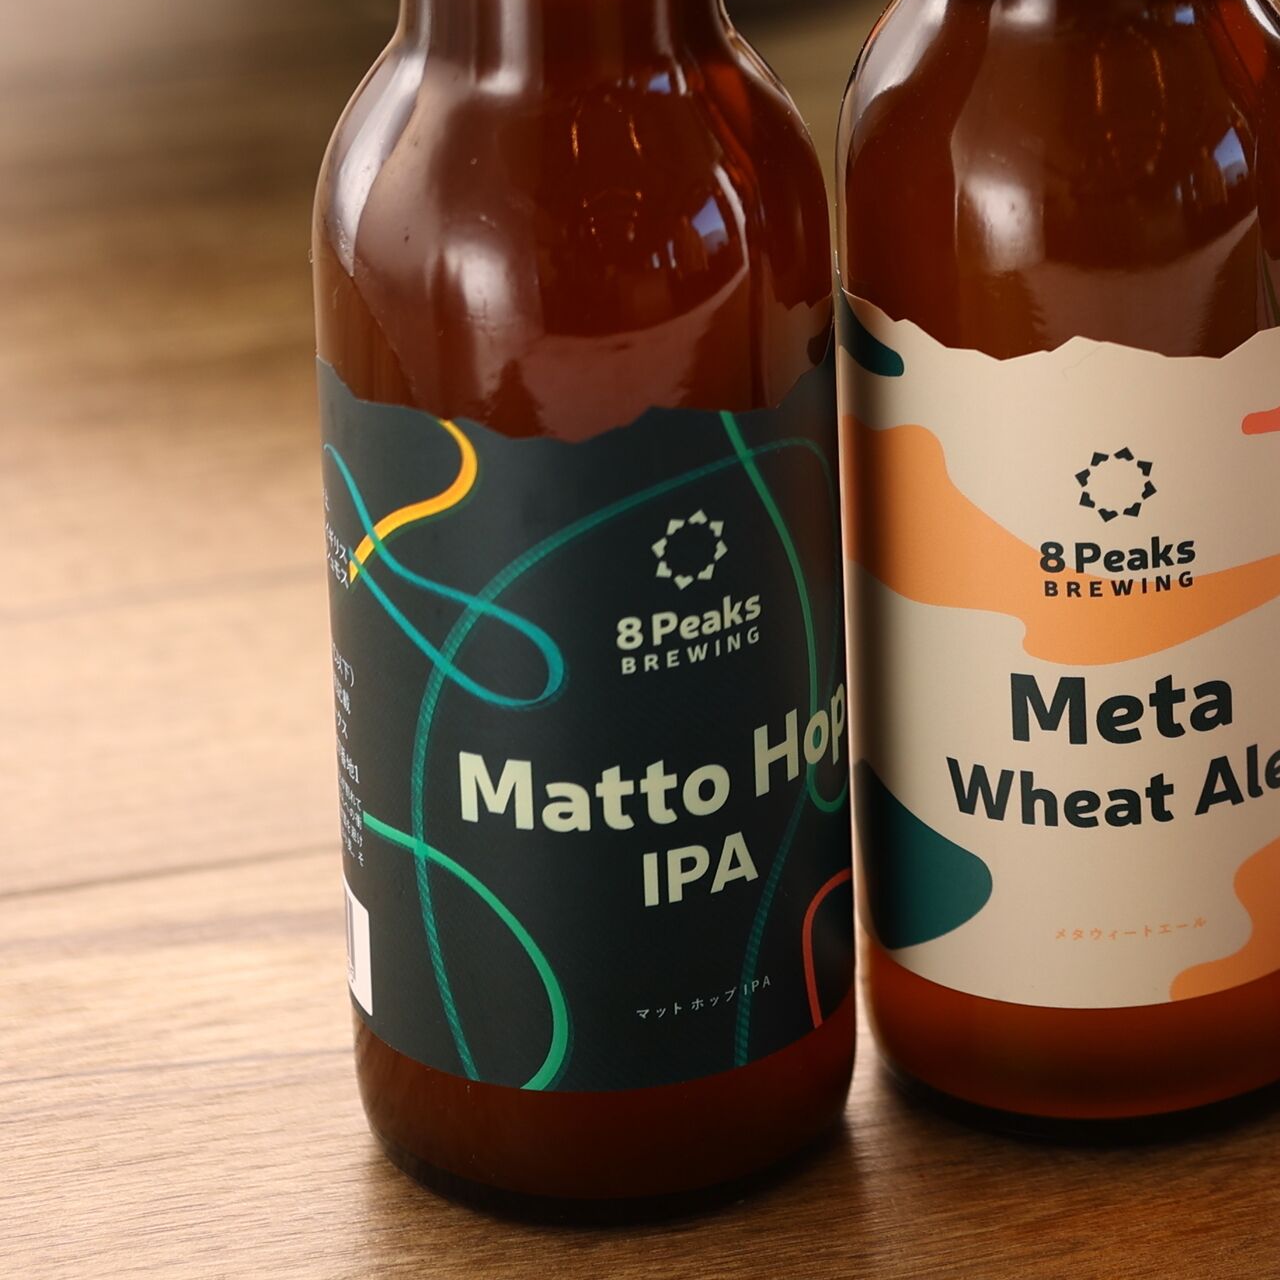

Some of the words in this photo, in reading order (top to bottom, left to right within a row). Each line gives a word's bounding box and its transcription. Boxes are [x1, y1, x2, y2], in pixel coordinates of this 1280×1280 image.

[1040, 541, 1065, 573] 8
[1075, 536, 1196, 573] Peaks
[1044, 571, 1194, 597] BREWING
[616, 616, 643, 650] 8
[652, 595, 761, 646] Peaks
[621, 627, 760, 675] BREWING
[1010, 673, 1234, 745] Meta
[459, 751, 730, 832] Matto
[754, 683, 845, 797] Hop
[946, 756, 1174, 828] Wheat
[642, 832, 758, 907] IPA
